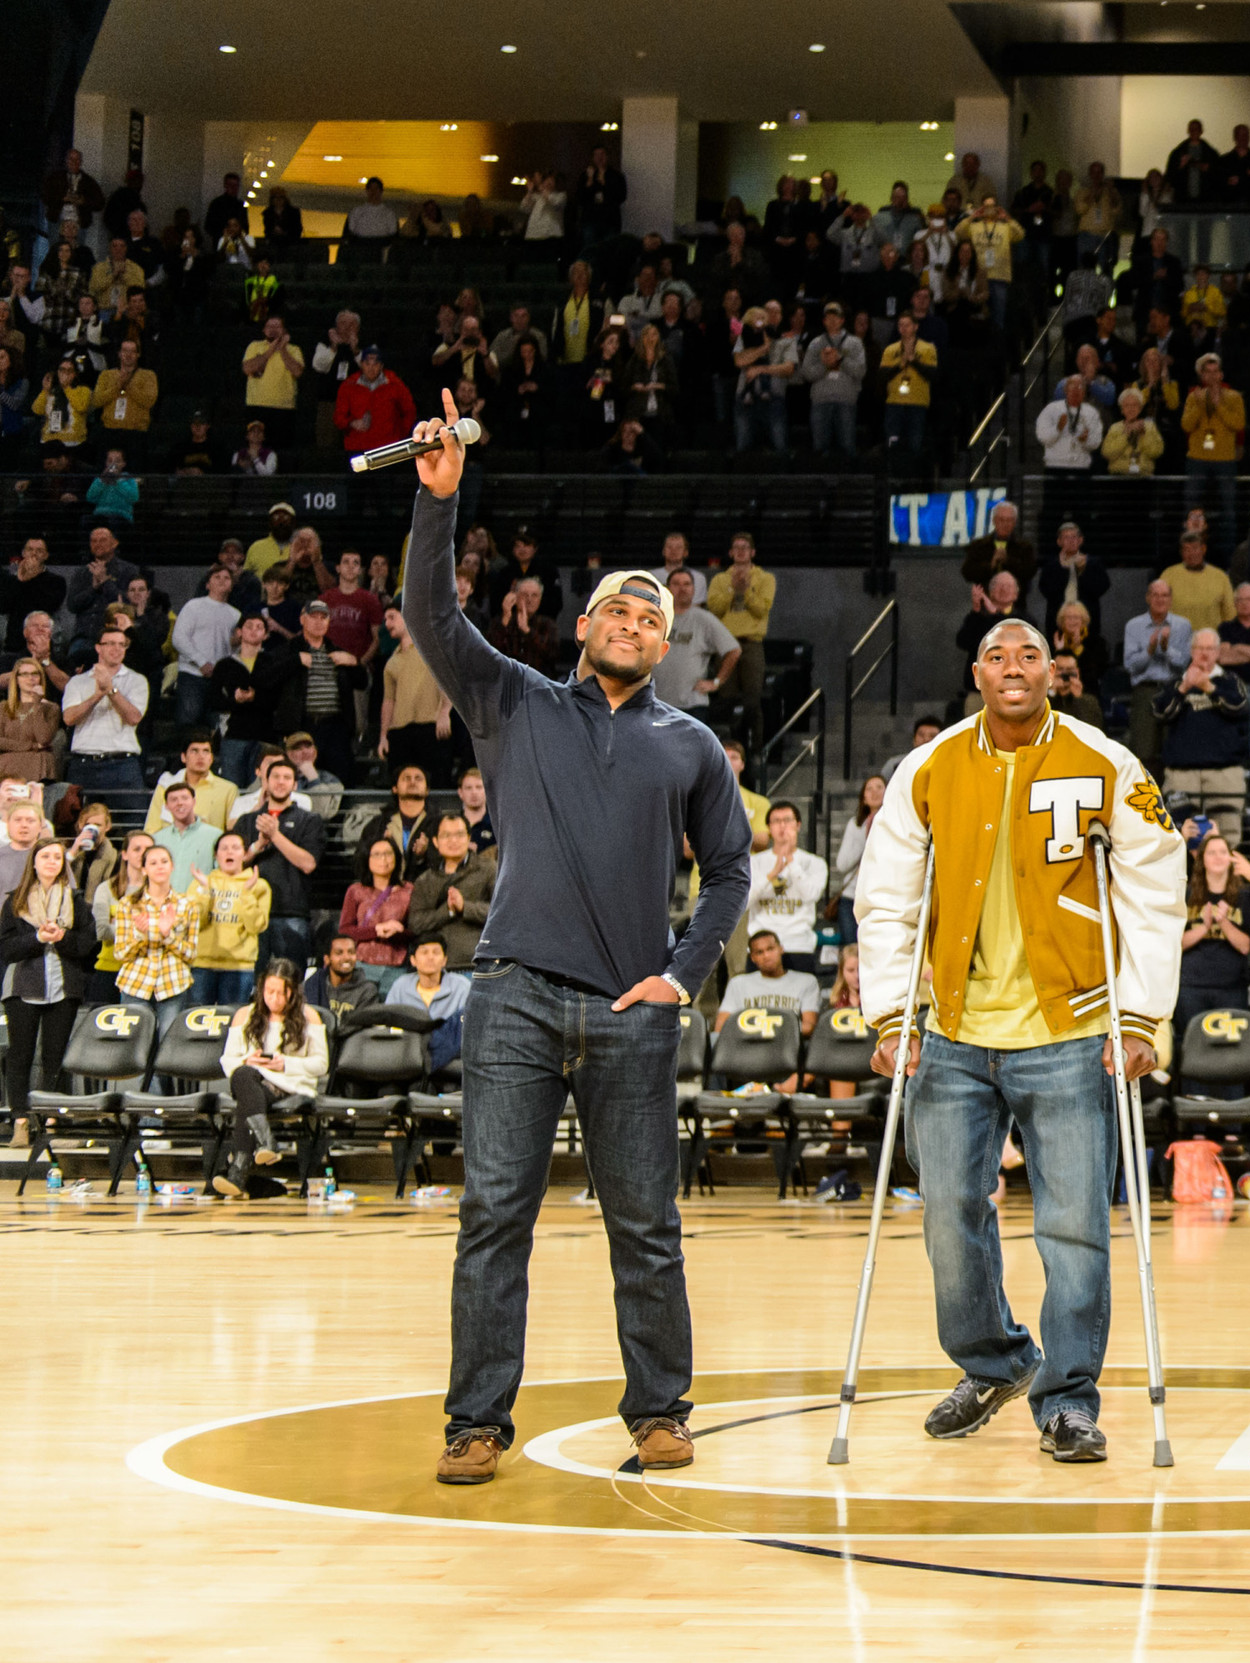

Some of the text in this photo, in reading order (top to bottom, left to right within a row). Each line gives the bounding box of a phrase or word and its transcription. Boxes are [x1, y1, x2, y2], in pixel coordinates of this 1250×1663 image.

[303, 492, 336, 510] 108
[1029, 776, 1105, 864] T
[95, 1008, 140, 1036] GT
[185, 1008, 231, 1036] GT
[737, 1008, 784, 1039] GT
[1201, 1010, 1248, 1042] GT
